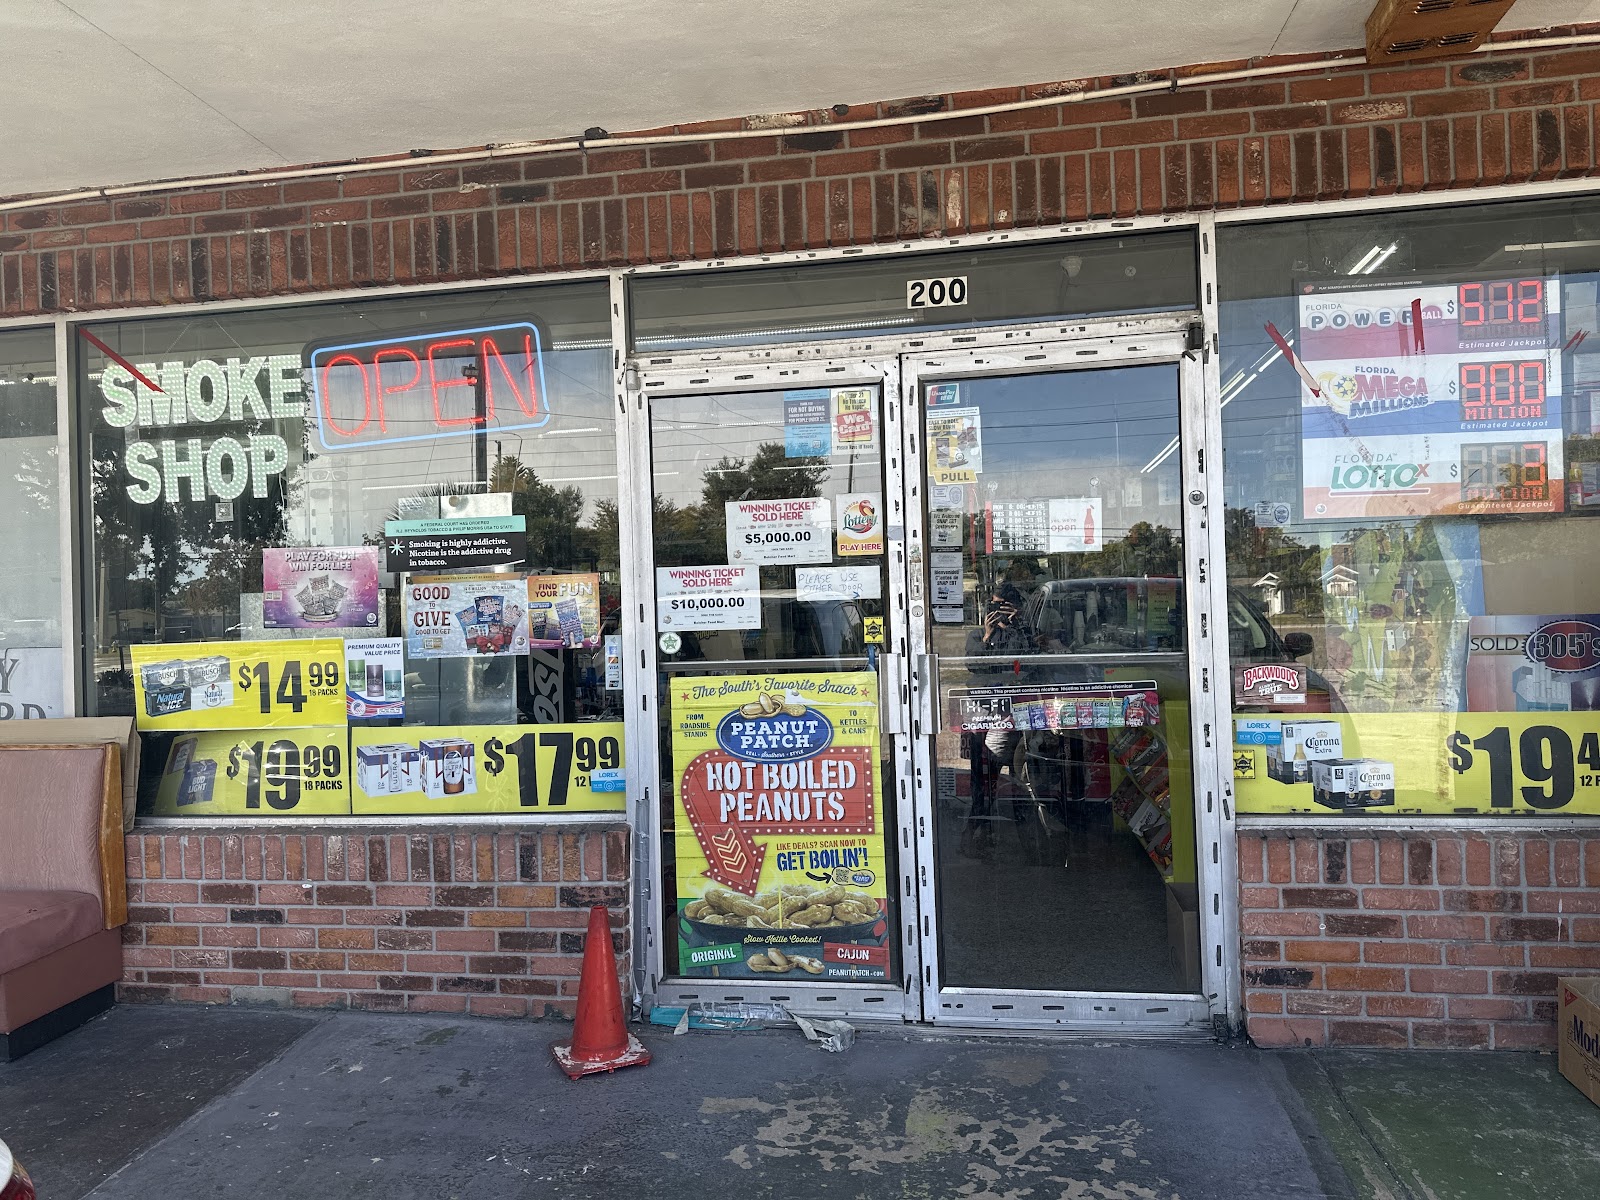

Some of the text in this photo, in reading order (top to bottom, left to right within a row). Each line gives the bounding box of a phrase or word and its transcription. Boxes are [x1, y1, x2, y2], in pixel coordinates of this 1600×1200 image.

[910, 278, 966, 307] 200
[1305, 303, 1342, 311] FLORIDA
[1460, 280, 1543, 326] 512
[1459, 338, 1546, 349] Estimated Jackpot
[1355, 365, 1396, 375] FLORIDA
[322, 334, 538, 437] OPEN
[1354, 373, 1428, 402] MEGA
[1461, 362, 1545, 407] 900
[101, 354, 305, 428] SMOKE
[808, 404, 825, 412] BUYING
[1349, 395, 1429, 418] MILLIONS
[838, 413, 872, 434] We Card
[1460, 420, 1548, 430] Estimated Jackpot
[1334, 453, 1393, 464] FLORIDA
[125, 434, 289, 505] SHOP
[941, 472, 970, 482] PULL
[739, 501, 816, 513] WINNING TICKET
[1457, 500, 1553, 510] Guaranteed Jackpot
[752, 511, 803, 522] SOLD HERE
[842, 512, 878, 531] Lottery
[1051, 524, 1077, 532] open
[409, 540, 440, 549] Smoking
[449, 539, 472, 549] highly
[473, 538, 508, 546] addictive.
[745, 531, 811, 545] $5,000.00
[409, 549, 440, 557] Nicotine
[494, 547, 511, 556] drug
[840, 543, 882, 551] PLAY HERE
[285, 551, 309, 562] PLAY
[312, 550, 334, 561] FOR
[289, 561, 353, 572] WIN FOR LIFE
[669, 567, 745, 579] WINNING TICKET
[797, 572, 858, 584] PLEASE USE
[682, 577, 733, 588] SOLD HERE
[803, 583, 864, 593] OTHER DOOR
[412, 586, 451, 601] GOOD
[559, 581, 593, 597] FUN
[671, 597, 745, 610] $10,000.00
[414, 611, 451, 627] GIVE
[1470, 637, 1519, 651] SOLD
[158, 670, 178, 680] BUSCH
[202, 666, 221, 677] BUSCH
[1243, 665, 1299, 691] BACKWOODS
[204, 688, 223, 698] Natural
[317, 688, 339, 696] PACKS
[693, 677, 858, 700] The South's Favorite Snack
[1258, 684, 1283, 696] TRUE
[157, 690, 185, 703] Natural
[167, 699, 182, 709] ICE
[849, 709, 858, 717] TO
[972, 713, 1002, 722] PREMIUM
[680, 722, 711, 730] ROADSIDE
[839, 718, 868, 726] KETTLES
[961, 721, 1014, 731] CIGARILLOS
[730, 720, 819, 736] PEANUT
[684, 730, 708, 738] STANDS
[740, 734, 810, 749] PATCH
[1305, 736, 1340, 750] Corona
[789, 749, 804, 757] STYLE
[191, 776, 206, 785] BUD
[705, 759, 857, 792] HOT BOILED
[1359, 771, 1391, 783] Corona
[1580, 775, 1593, 786] 12
[304, 780, 342, 790] 18 PACKS
[574, 776, 586, 787] 12
[1368, 779, 1384, 787] Extra
[188, 783, 207, 793] LIGHT
[720, 791, 845, 823] PEANUTS
[776, 838, 867, 851] LIKE DEALS? SCAN NOW TO
[776, 847, 869, 872] GET BOILIN'!
[743, 934, 822, 945] Slow Kettle Cooked!
[691, 947, 737, 963] ORIGINAL
[836, 948, 870, 961] CAJUN
